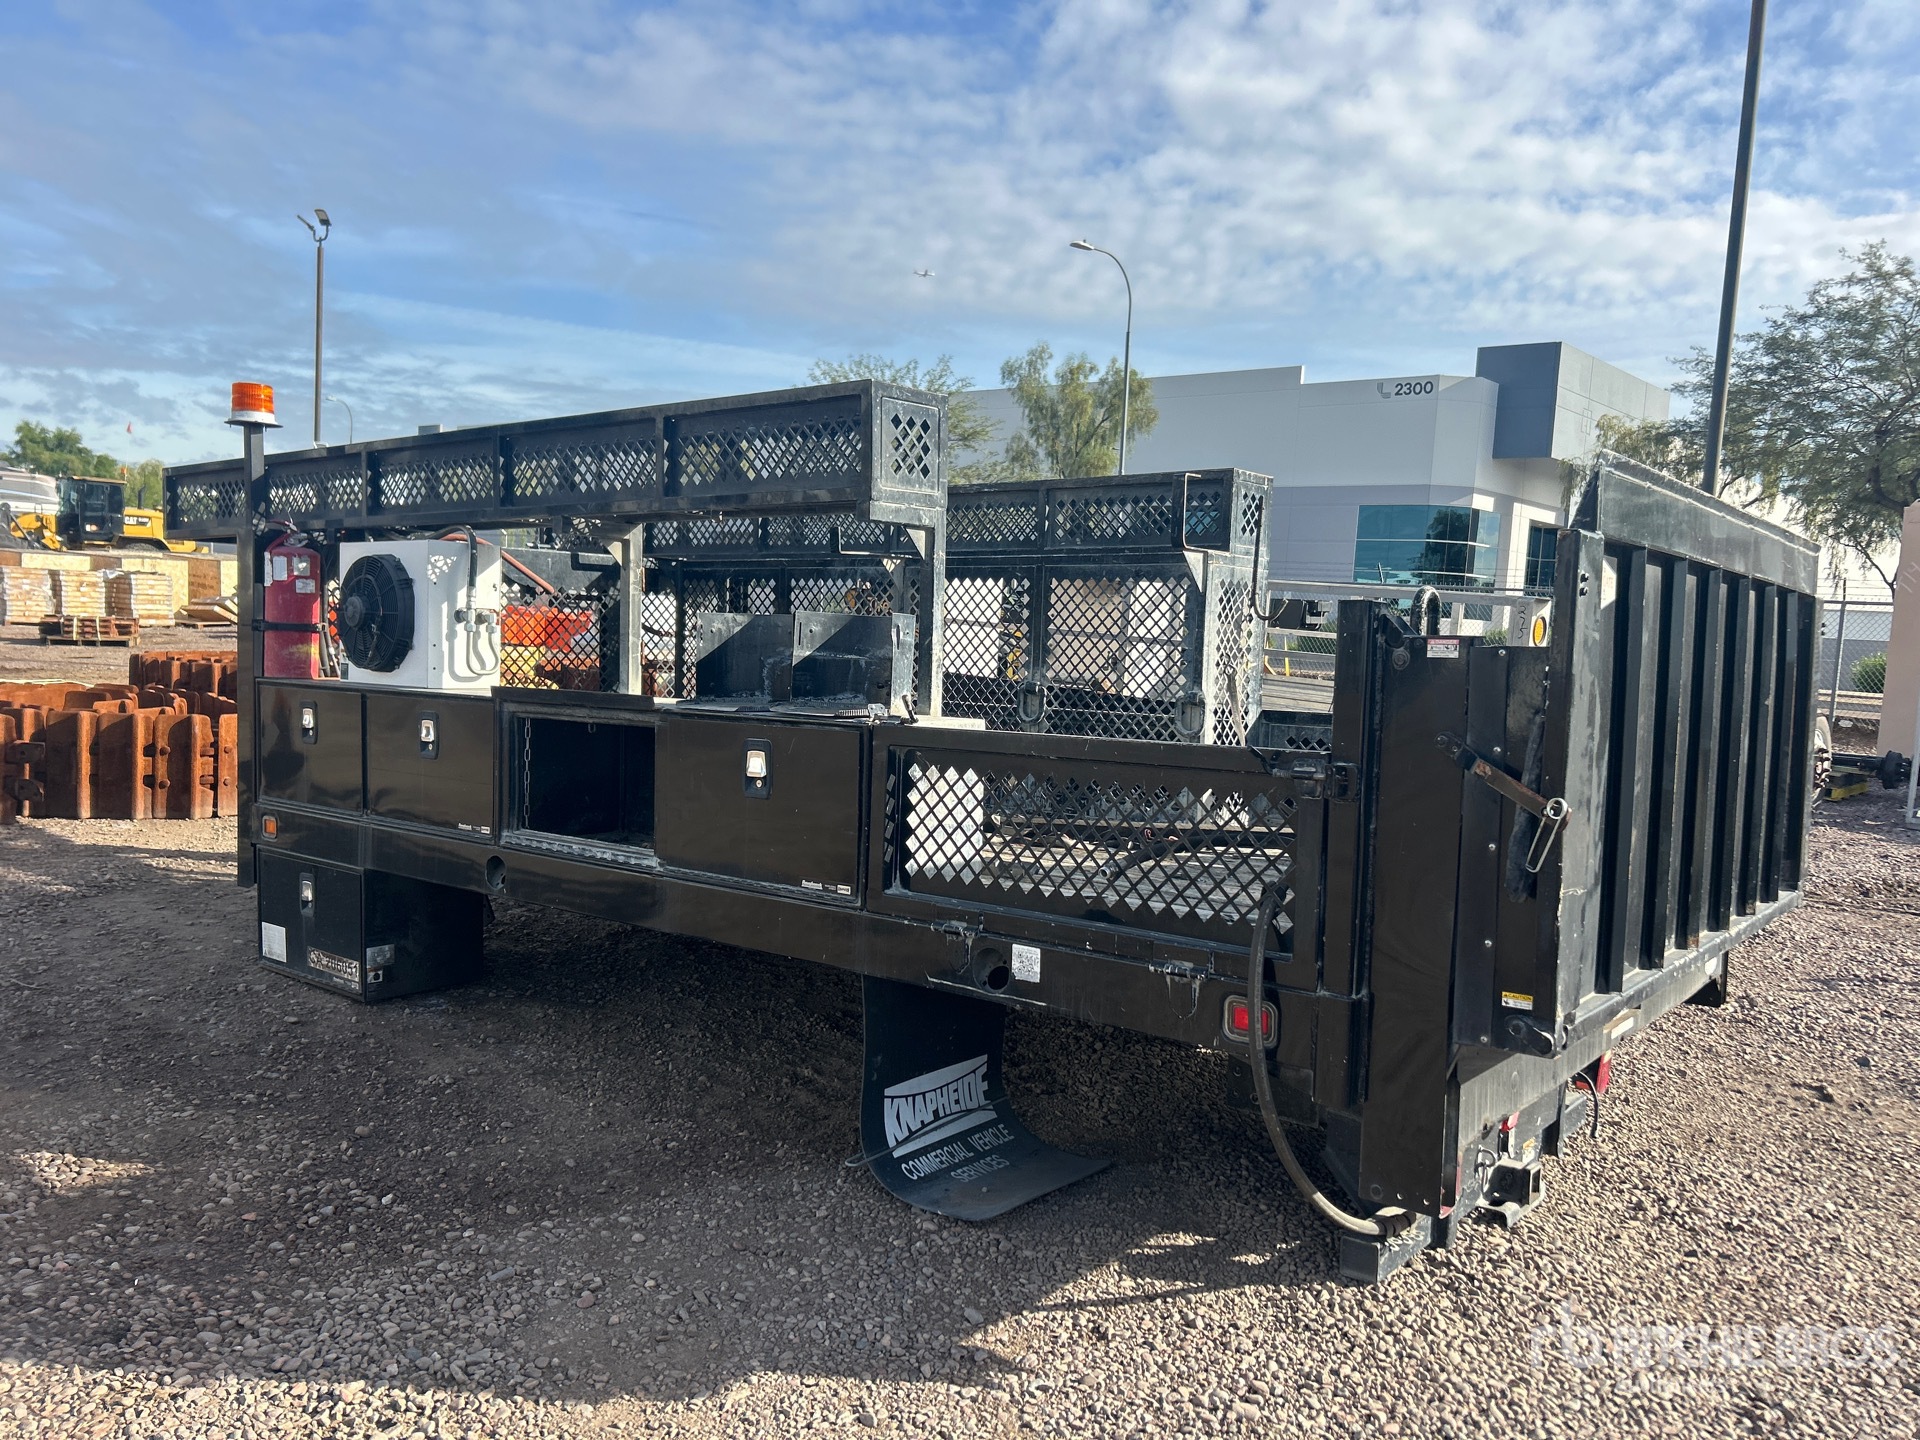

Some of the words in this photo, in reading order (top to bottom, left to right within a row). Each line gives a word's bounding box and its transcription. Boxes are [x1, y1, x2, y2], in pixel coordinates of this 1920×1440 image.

[1394, 380, 1434, 396] 2300
[124, 516, 138, 525] CAT
[884, 1063, 991, 1149] KNAPHEIDE
[901, 1141, 975, 1180] COMMERCIAL
[967, 1124, 1015, 1153] VEHICLE
[950, 1154, 1010, 1183] SERVICES
